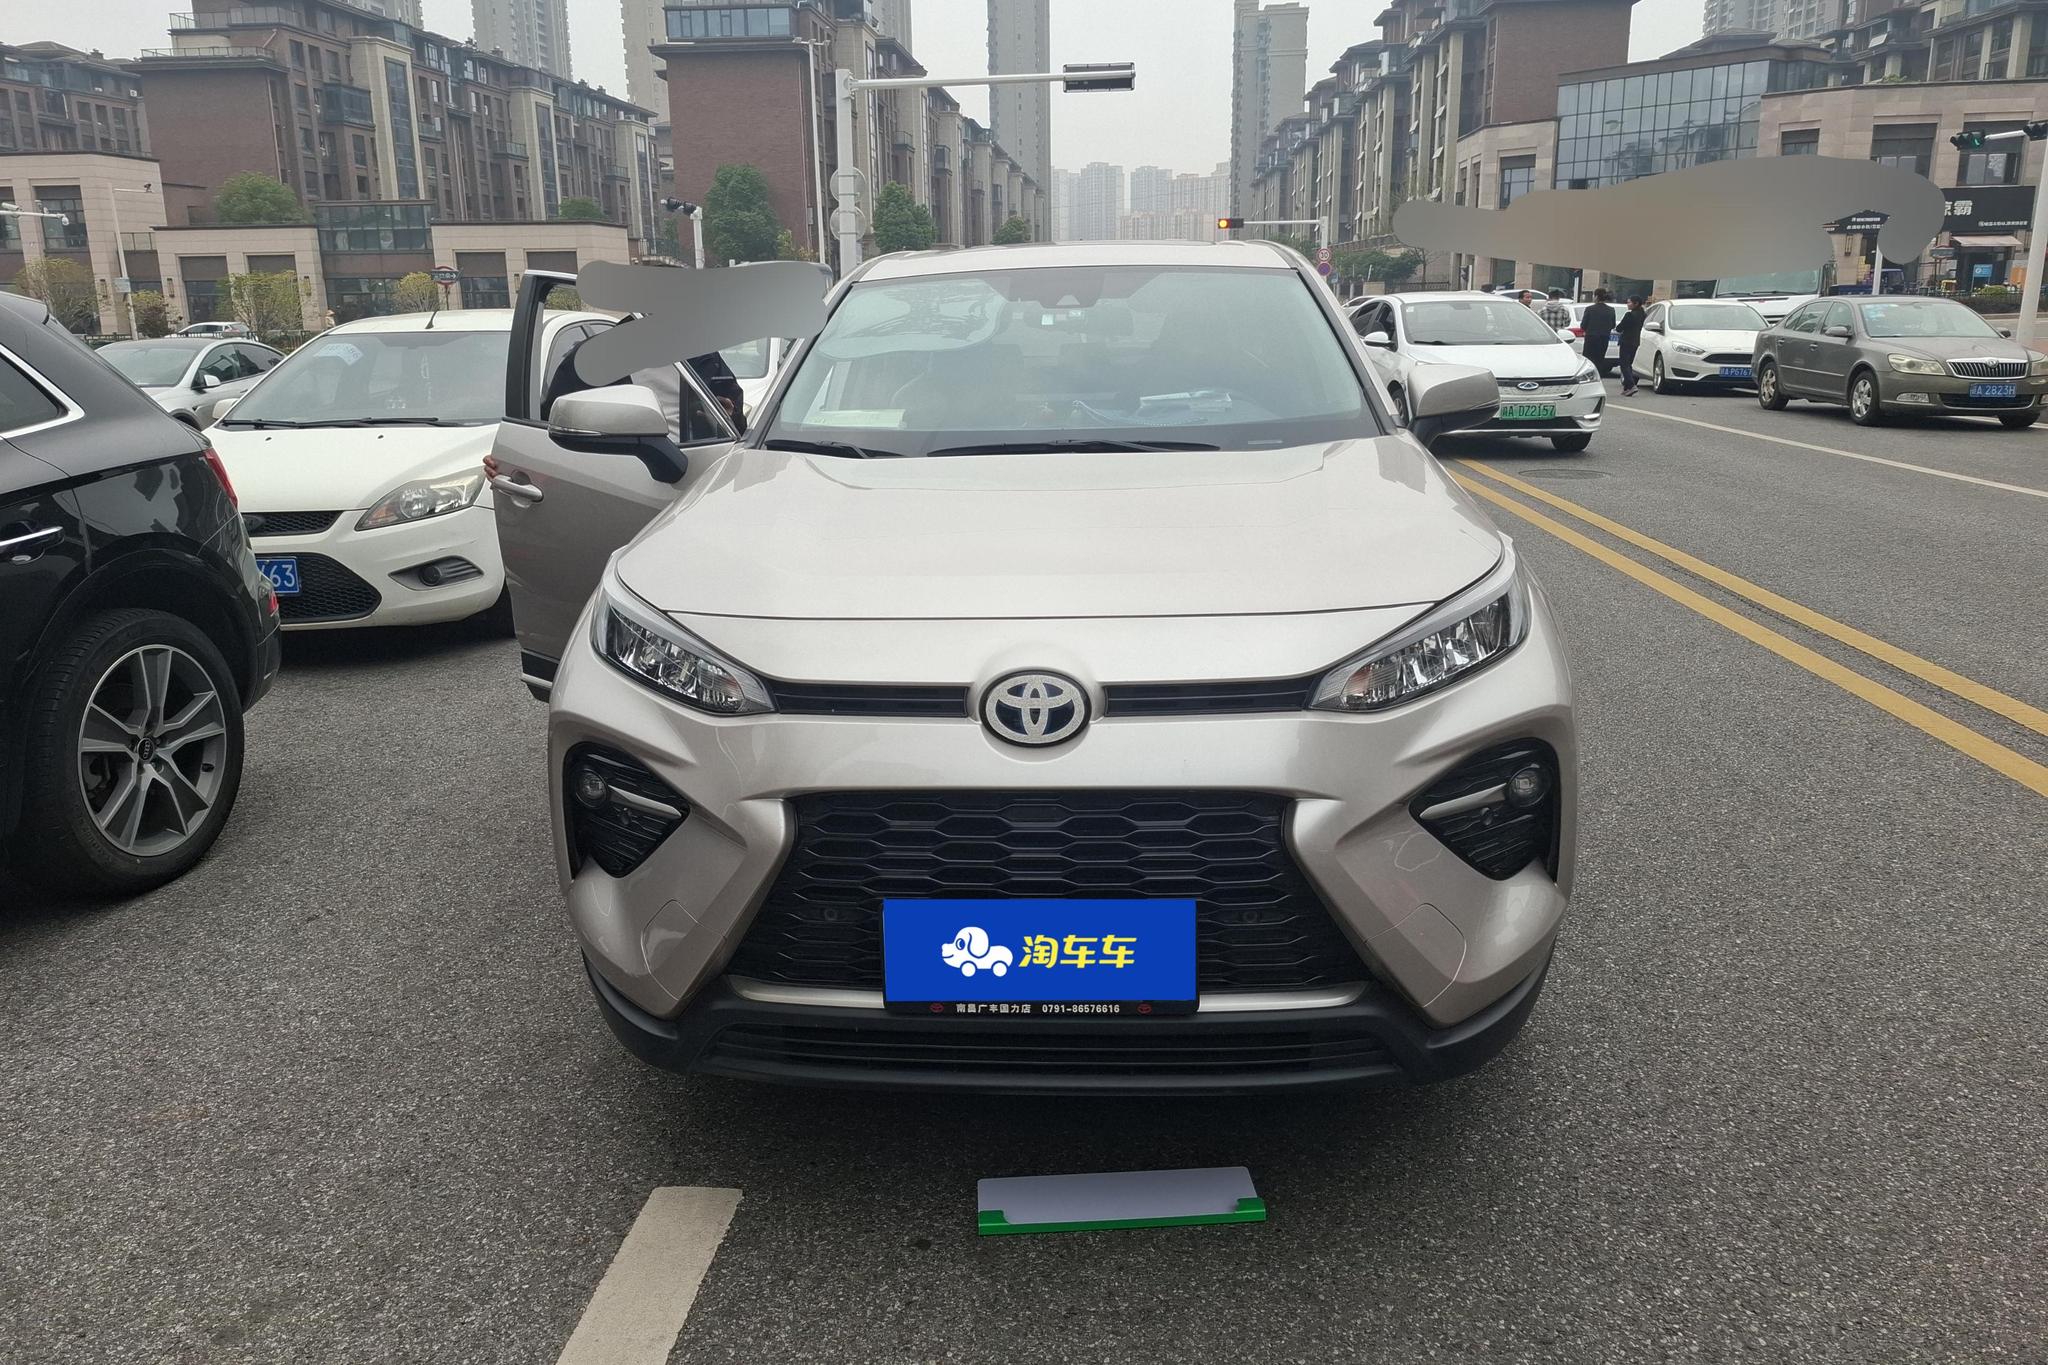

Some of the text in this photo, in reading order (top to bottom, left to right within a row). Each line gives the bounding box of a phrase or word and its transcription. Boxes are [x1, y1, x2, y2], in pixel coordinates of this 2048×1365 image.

[261, 564, 295, 587] 63
[956, 1003, 1120, 1014] 南昌广丰国力店 0791-86576616
